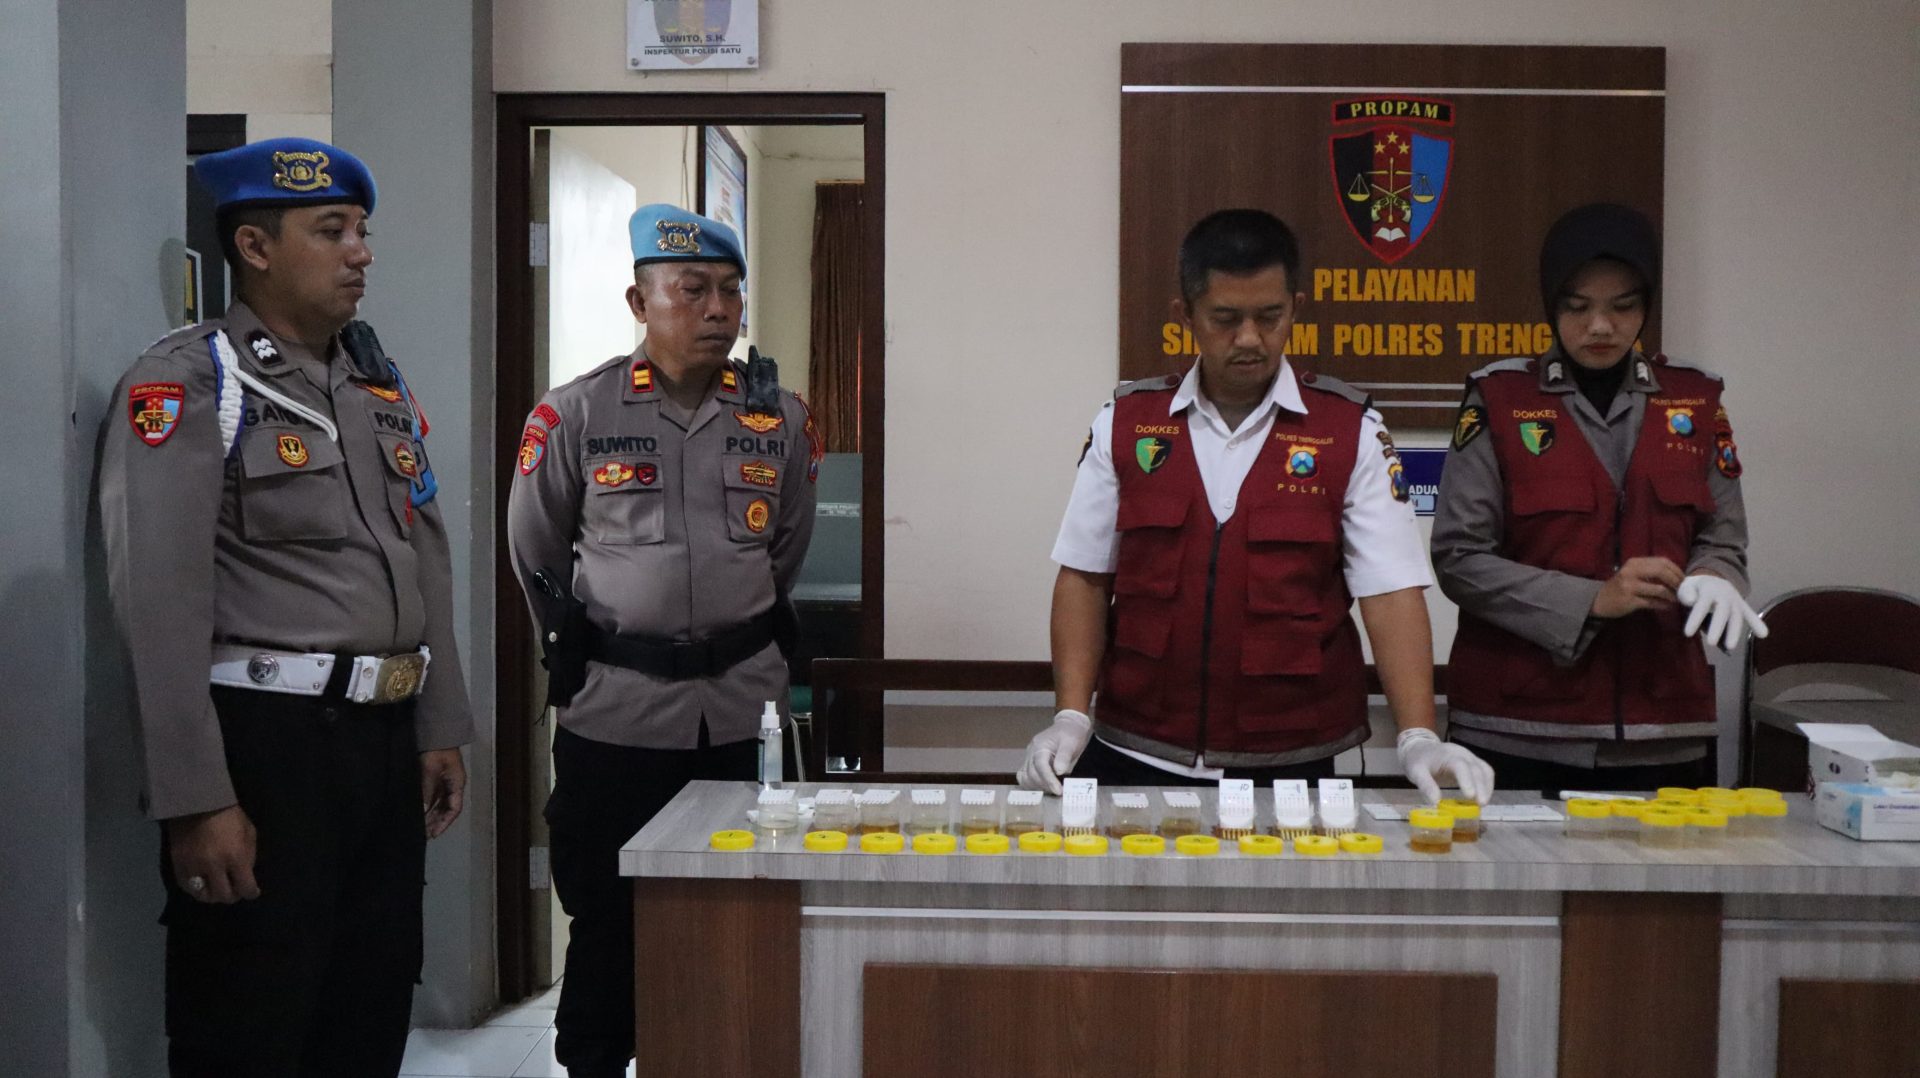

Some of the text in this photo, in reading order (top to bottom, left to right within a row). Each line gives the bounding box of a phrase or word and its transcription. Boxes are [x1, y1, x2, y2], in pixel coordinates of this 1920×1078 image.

[660, 34, 726, 43] SUWITO, S.H.
[644, 48, 690, 56] INSPEKTUR
[1350, 101, 1439, 119] PROPAM
[1313, 268, 1476, 303] PELAYANAN
[1333, 323, 1444, 357] POLRES
[1456, 323, 1554, 356] TRENG
[1512, 409, 1558, 420] DOKKES
[1134, 424, 1181, 435] DOKKES
[586, 436, 657, 455] SUWITO
[725, 436, 786, 457] POLRI
[1277, 482, 1326, 496] POLRI
[1408, 484, 1439, 495] ADUA
